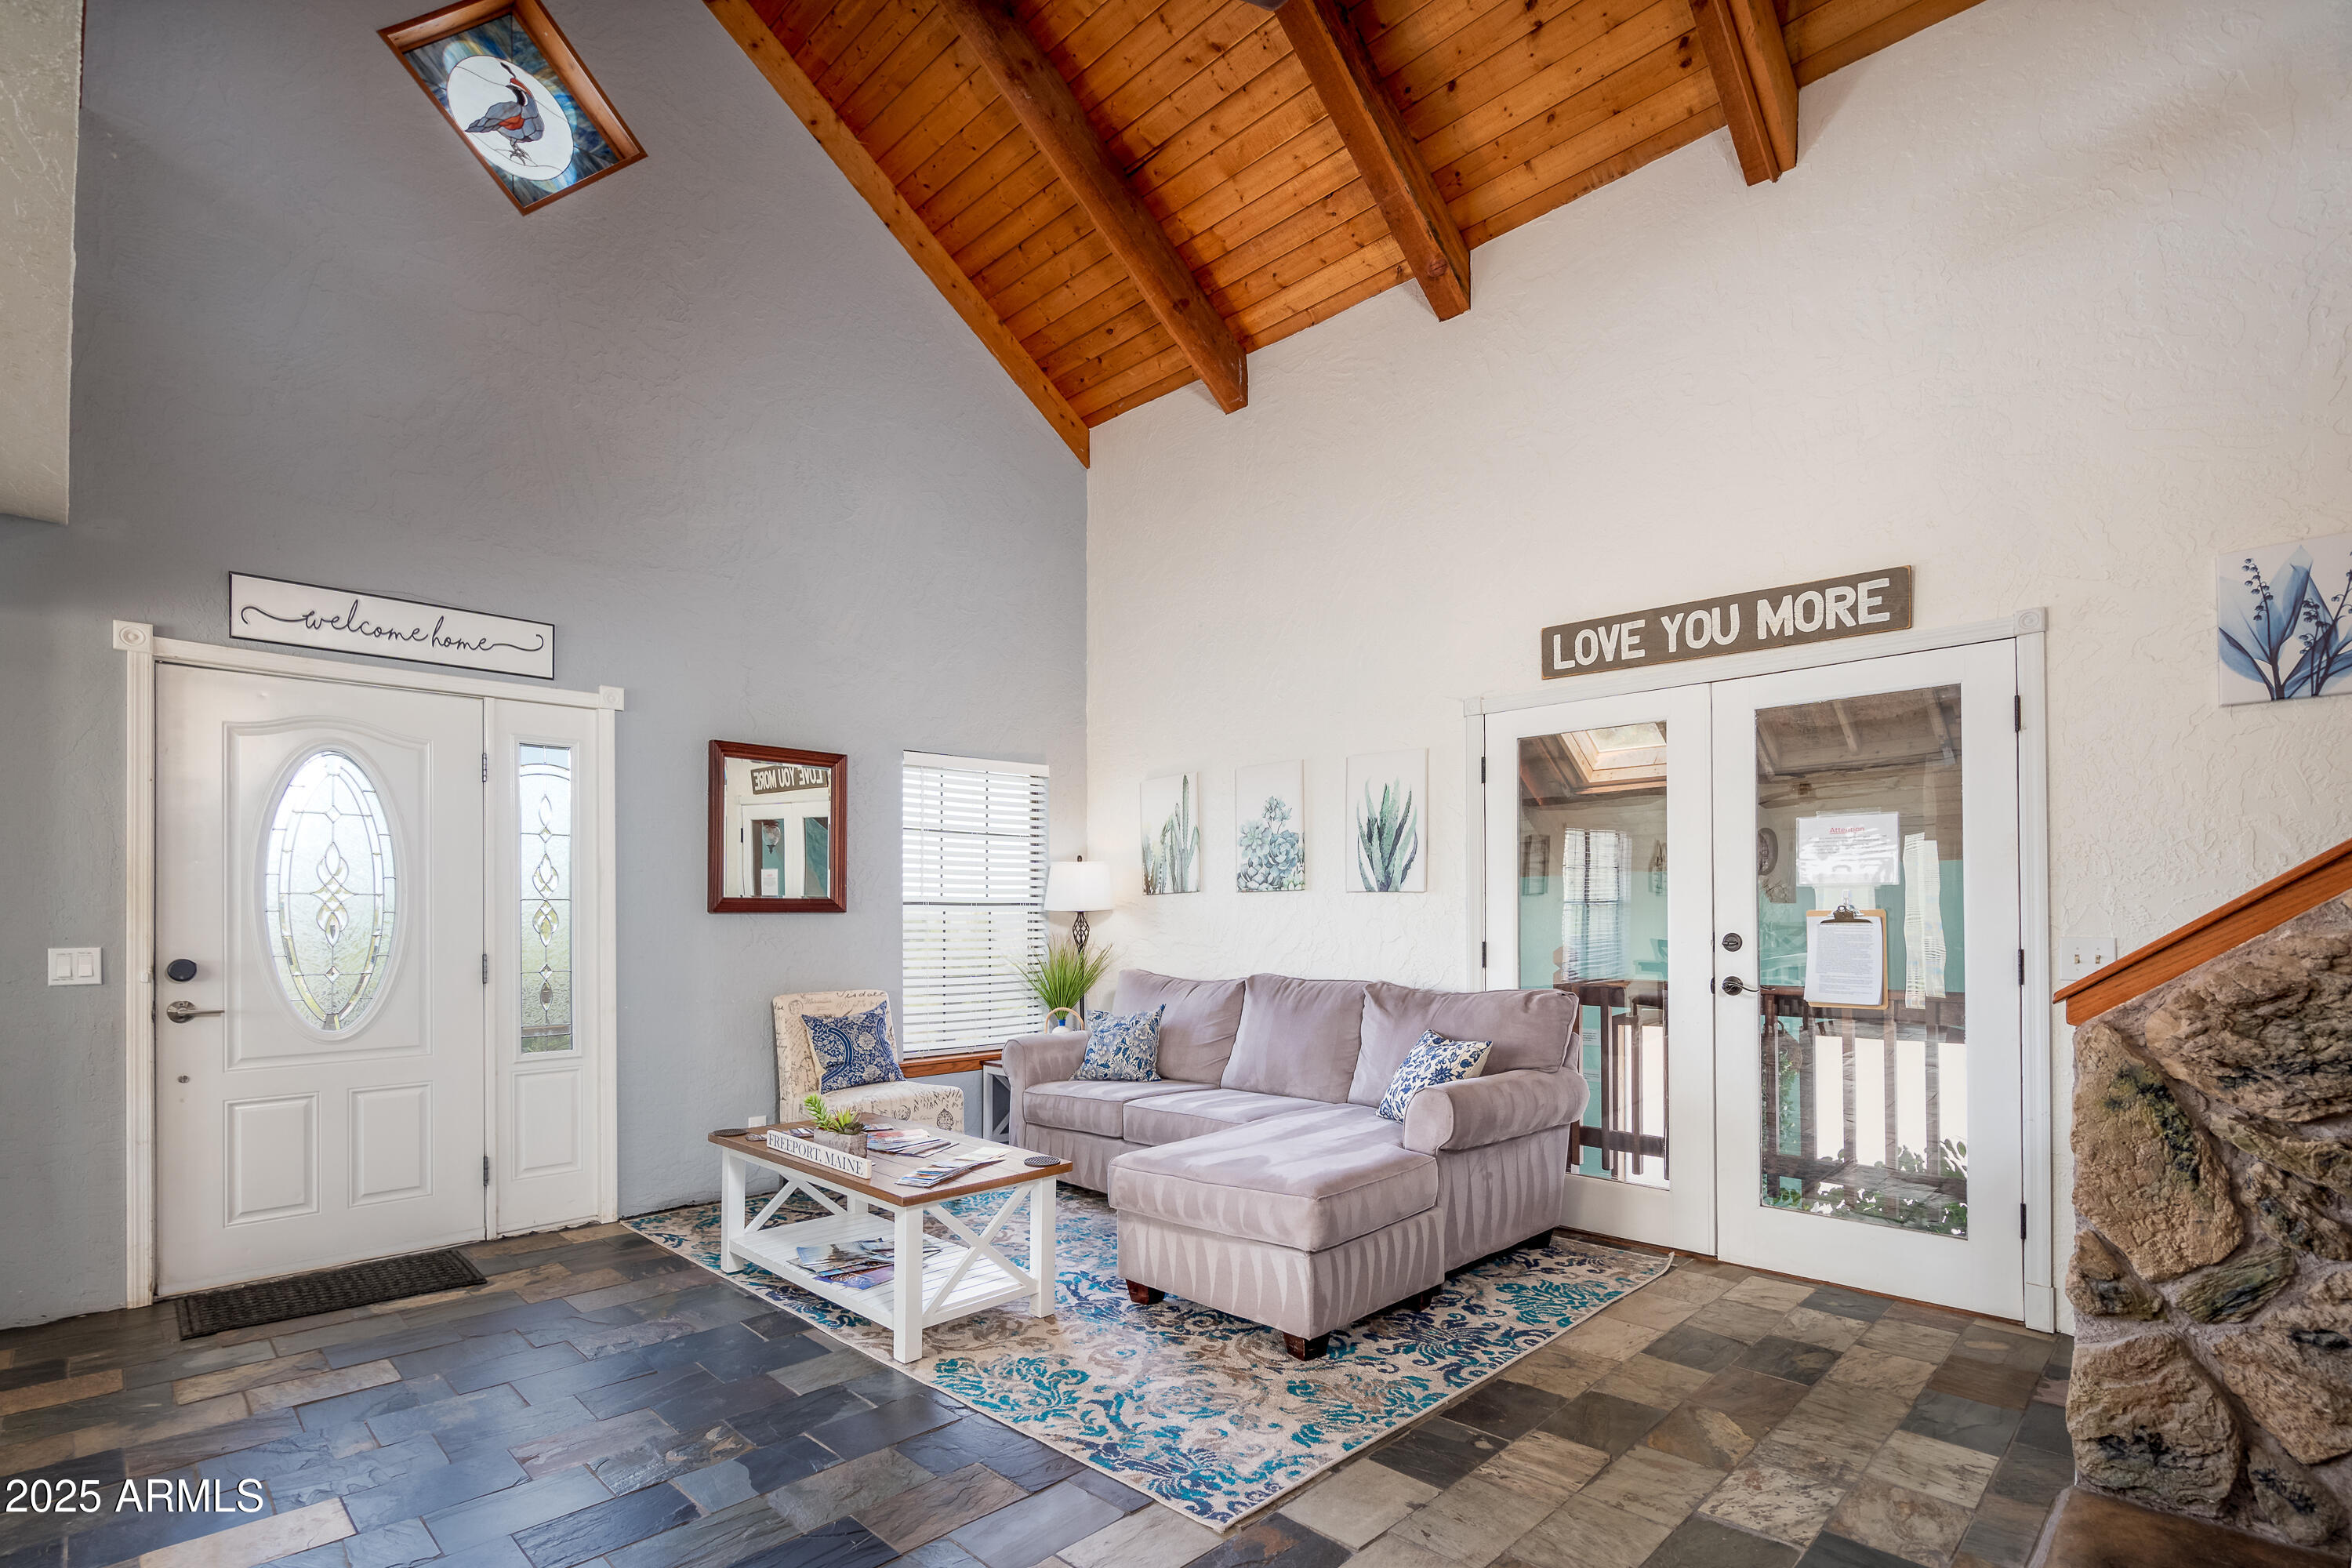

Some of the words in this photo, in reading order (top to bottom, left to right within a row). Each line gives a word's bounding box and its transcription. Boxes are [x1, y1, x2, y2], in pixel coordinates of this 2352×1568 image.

[302, 599, 429, 642] welcome
[430, 615, 496, 652] home
[1553, 619, 1646, 670] LOVE
[1660, 603, 1740, 653] YOU
[1756, 577, 1891, 641] MORE
[769, 1133, 822, 1163] FREEPORT,
[825, 1151, 863, 1175] MAINE
